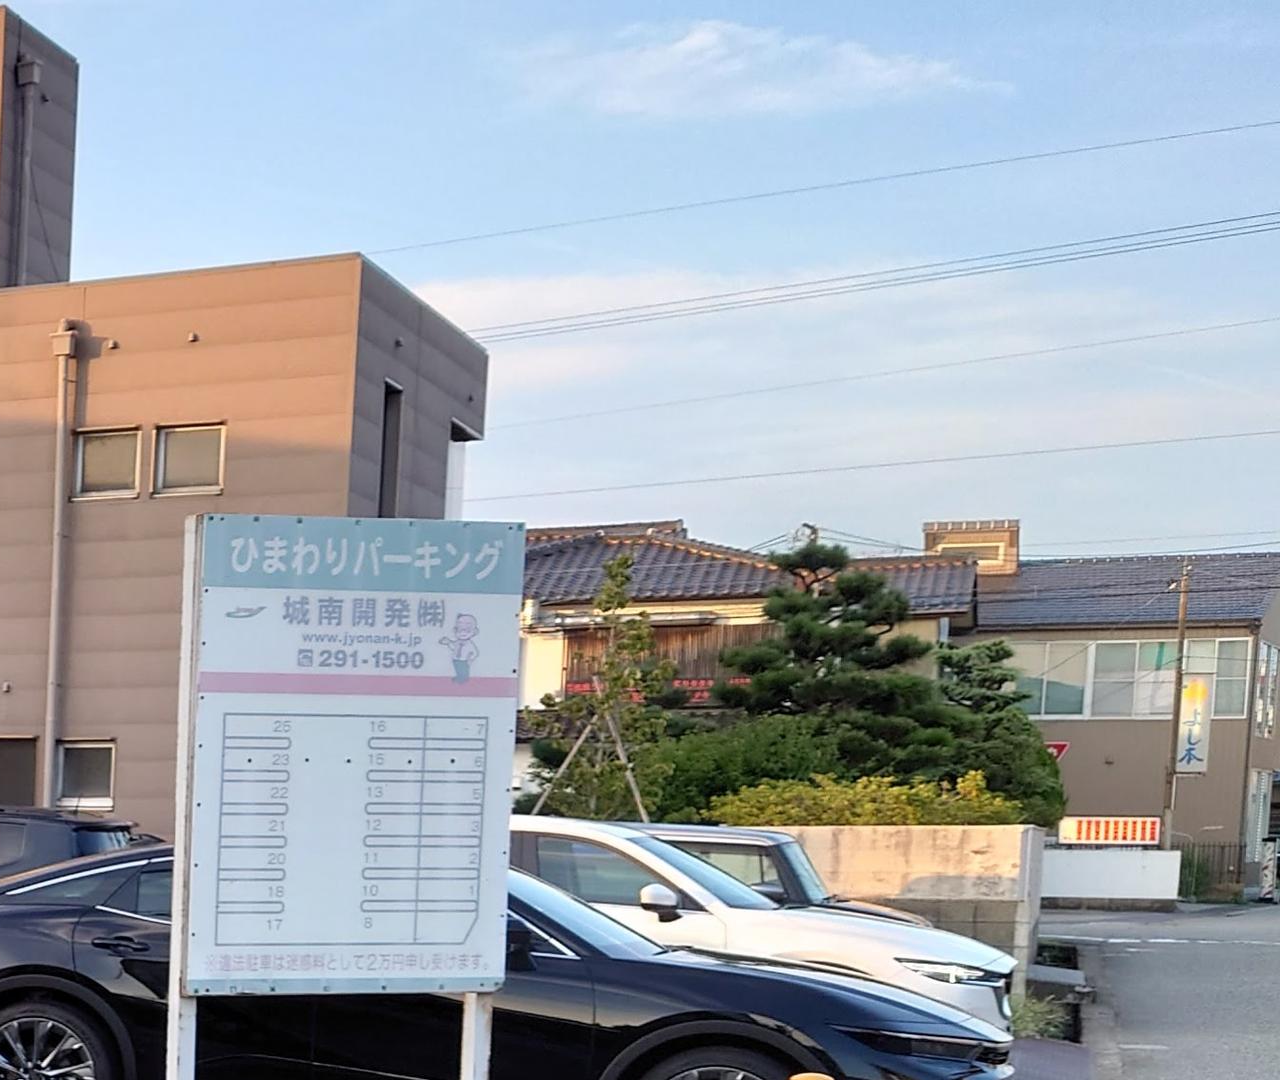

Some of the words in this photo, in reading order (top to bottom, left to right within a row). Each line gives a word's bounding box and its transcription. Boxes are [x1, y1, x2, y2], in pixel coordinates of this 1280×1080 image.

[230, 536, 504, 580] ひまわりパーキング
[302, 631, 423, 648] www.jyonan-k.jp
[318, 649, 425, 669] 291-1500
[370, 720, 386, 733] 16
[272, 754, 290, 766] 23
[270, 787, 289, 799] 22
[367, 786, 383, 798] 13
[268, 820, 286, 832] 21
[365, 819, 382, 831] 12
[267, 853, 286, 865] 20
[364, 853, 379, 864] 11
[268, 886, 284, 898] 18
[363, 885, 379, 897] 10
[267, 919, 283, 931] 17
